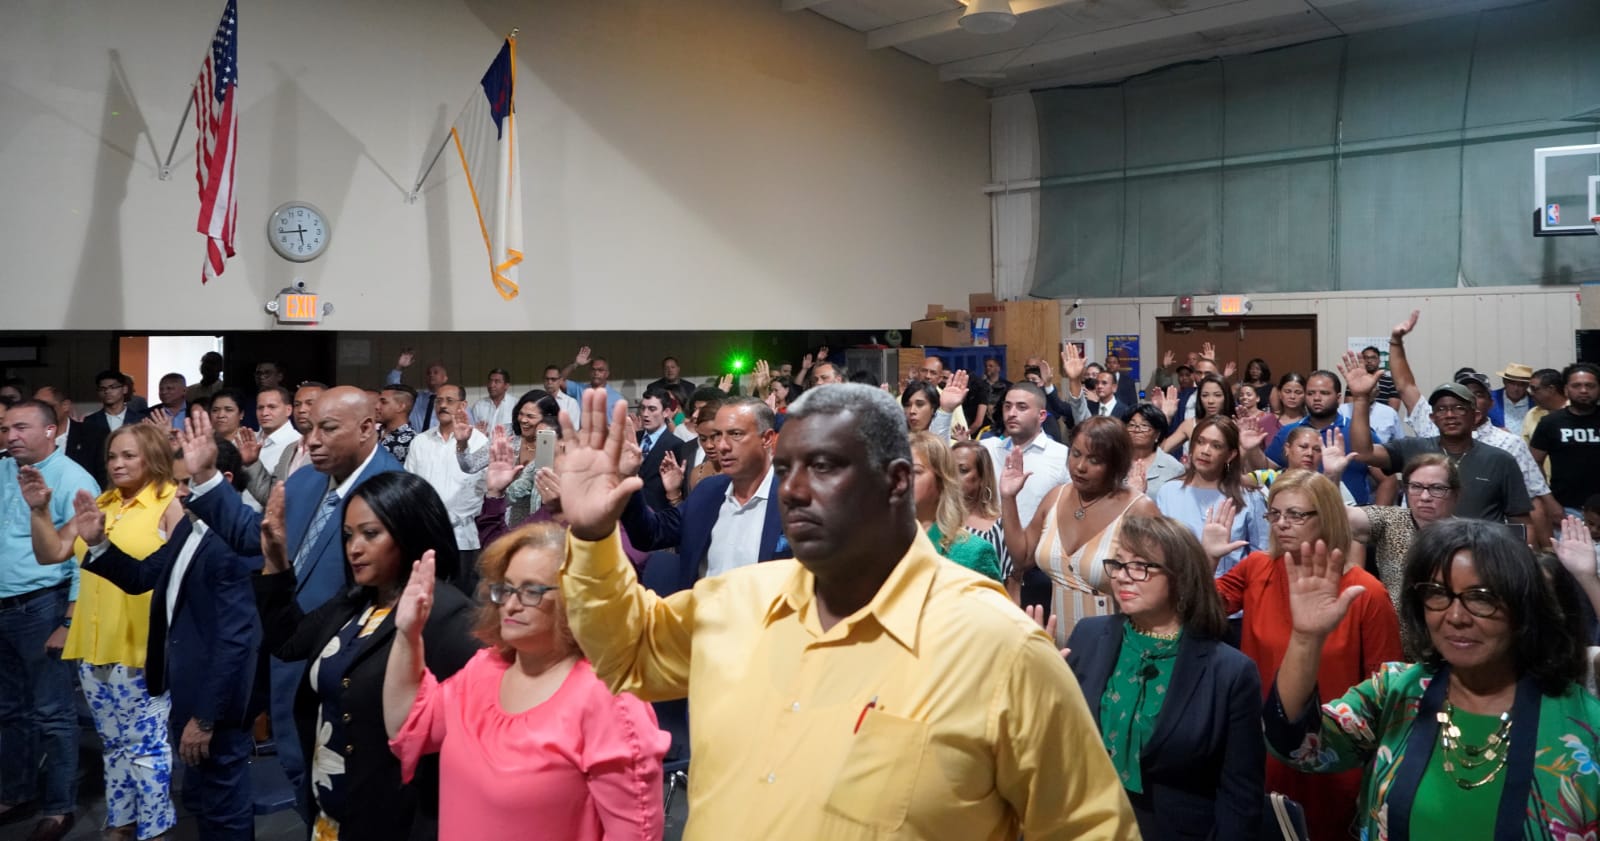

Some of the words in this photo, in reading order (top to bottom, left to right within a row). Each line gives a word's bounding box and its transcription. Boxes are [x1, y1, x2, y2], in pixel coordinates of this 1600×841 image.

[315, 228, 321, 236] 3
[281, 235, 288, 243] 8
[287, 295, 317, 318] EXIT
[1221, 296, 1241, 313] EXIT
